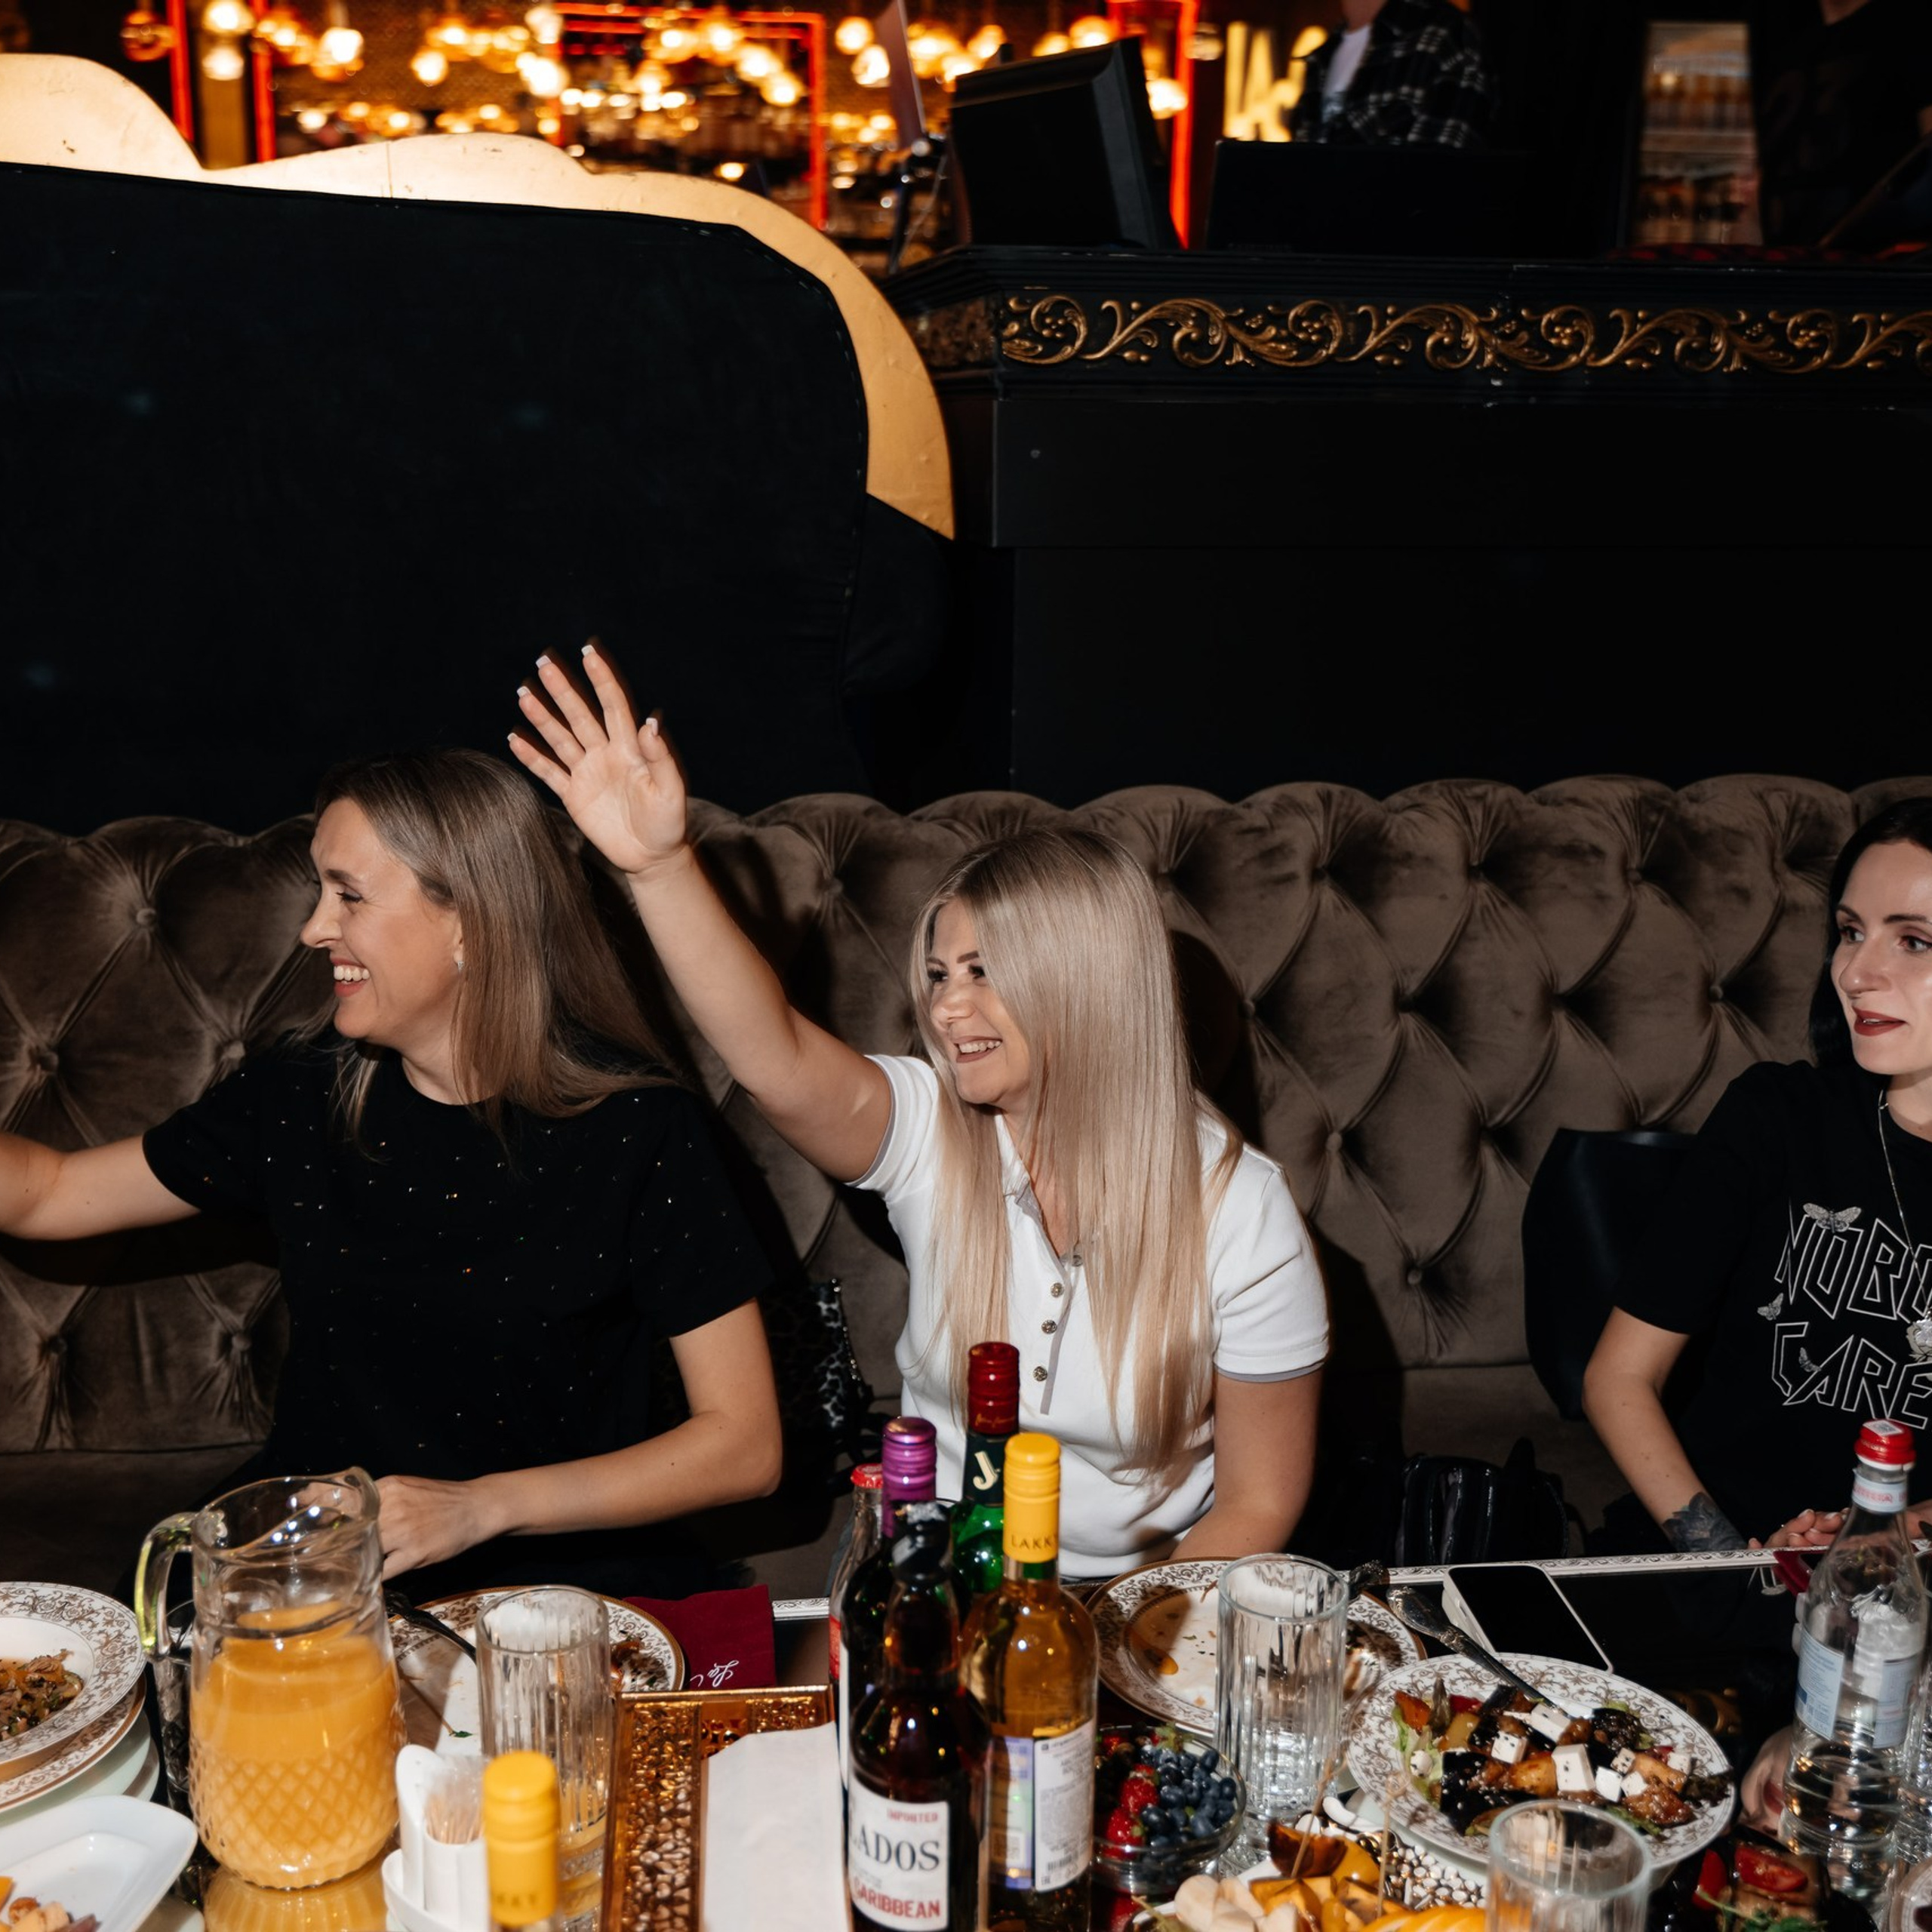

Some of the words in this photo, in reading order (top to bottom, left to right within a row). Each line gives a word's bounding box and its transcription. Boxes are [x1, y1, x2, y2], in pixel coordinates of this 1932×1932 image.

[1772, 1321, 1932, 1429] CARE
[973, 1451, 1000, 1490] J
[1011, 1534, 1058, 1549] LAKK
[887, 1808, 939, 1823] IMPORTED
[853, 1824, 940, 1872] ADOS
